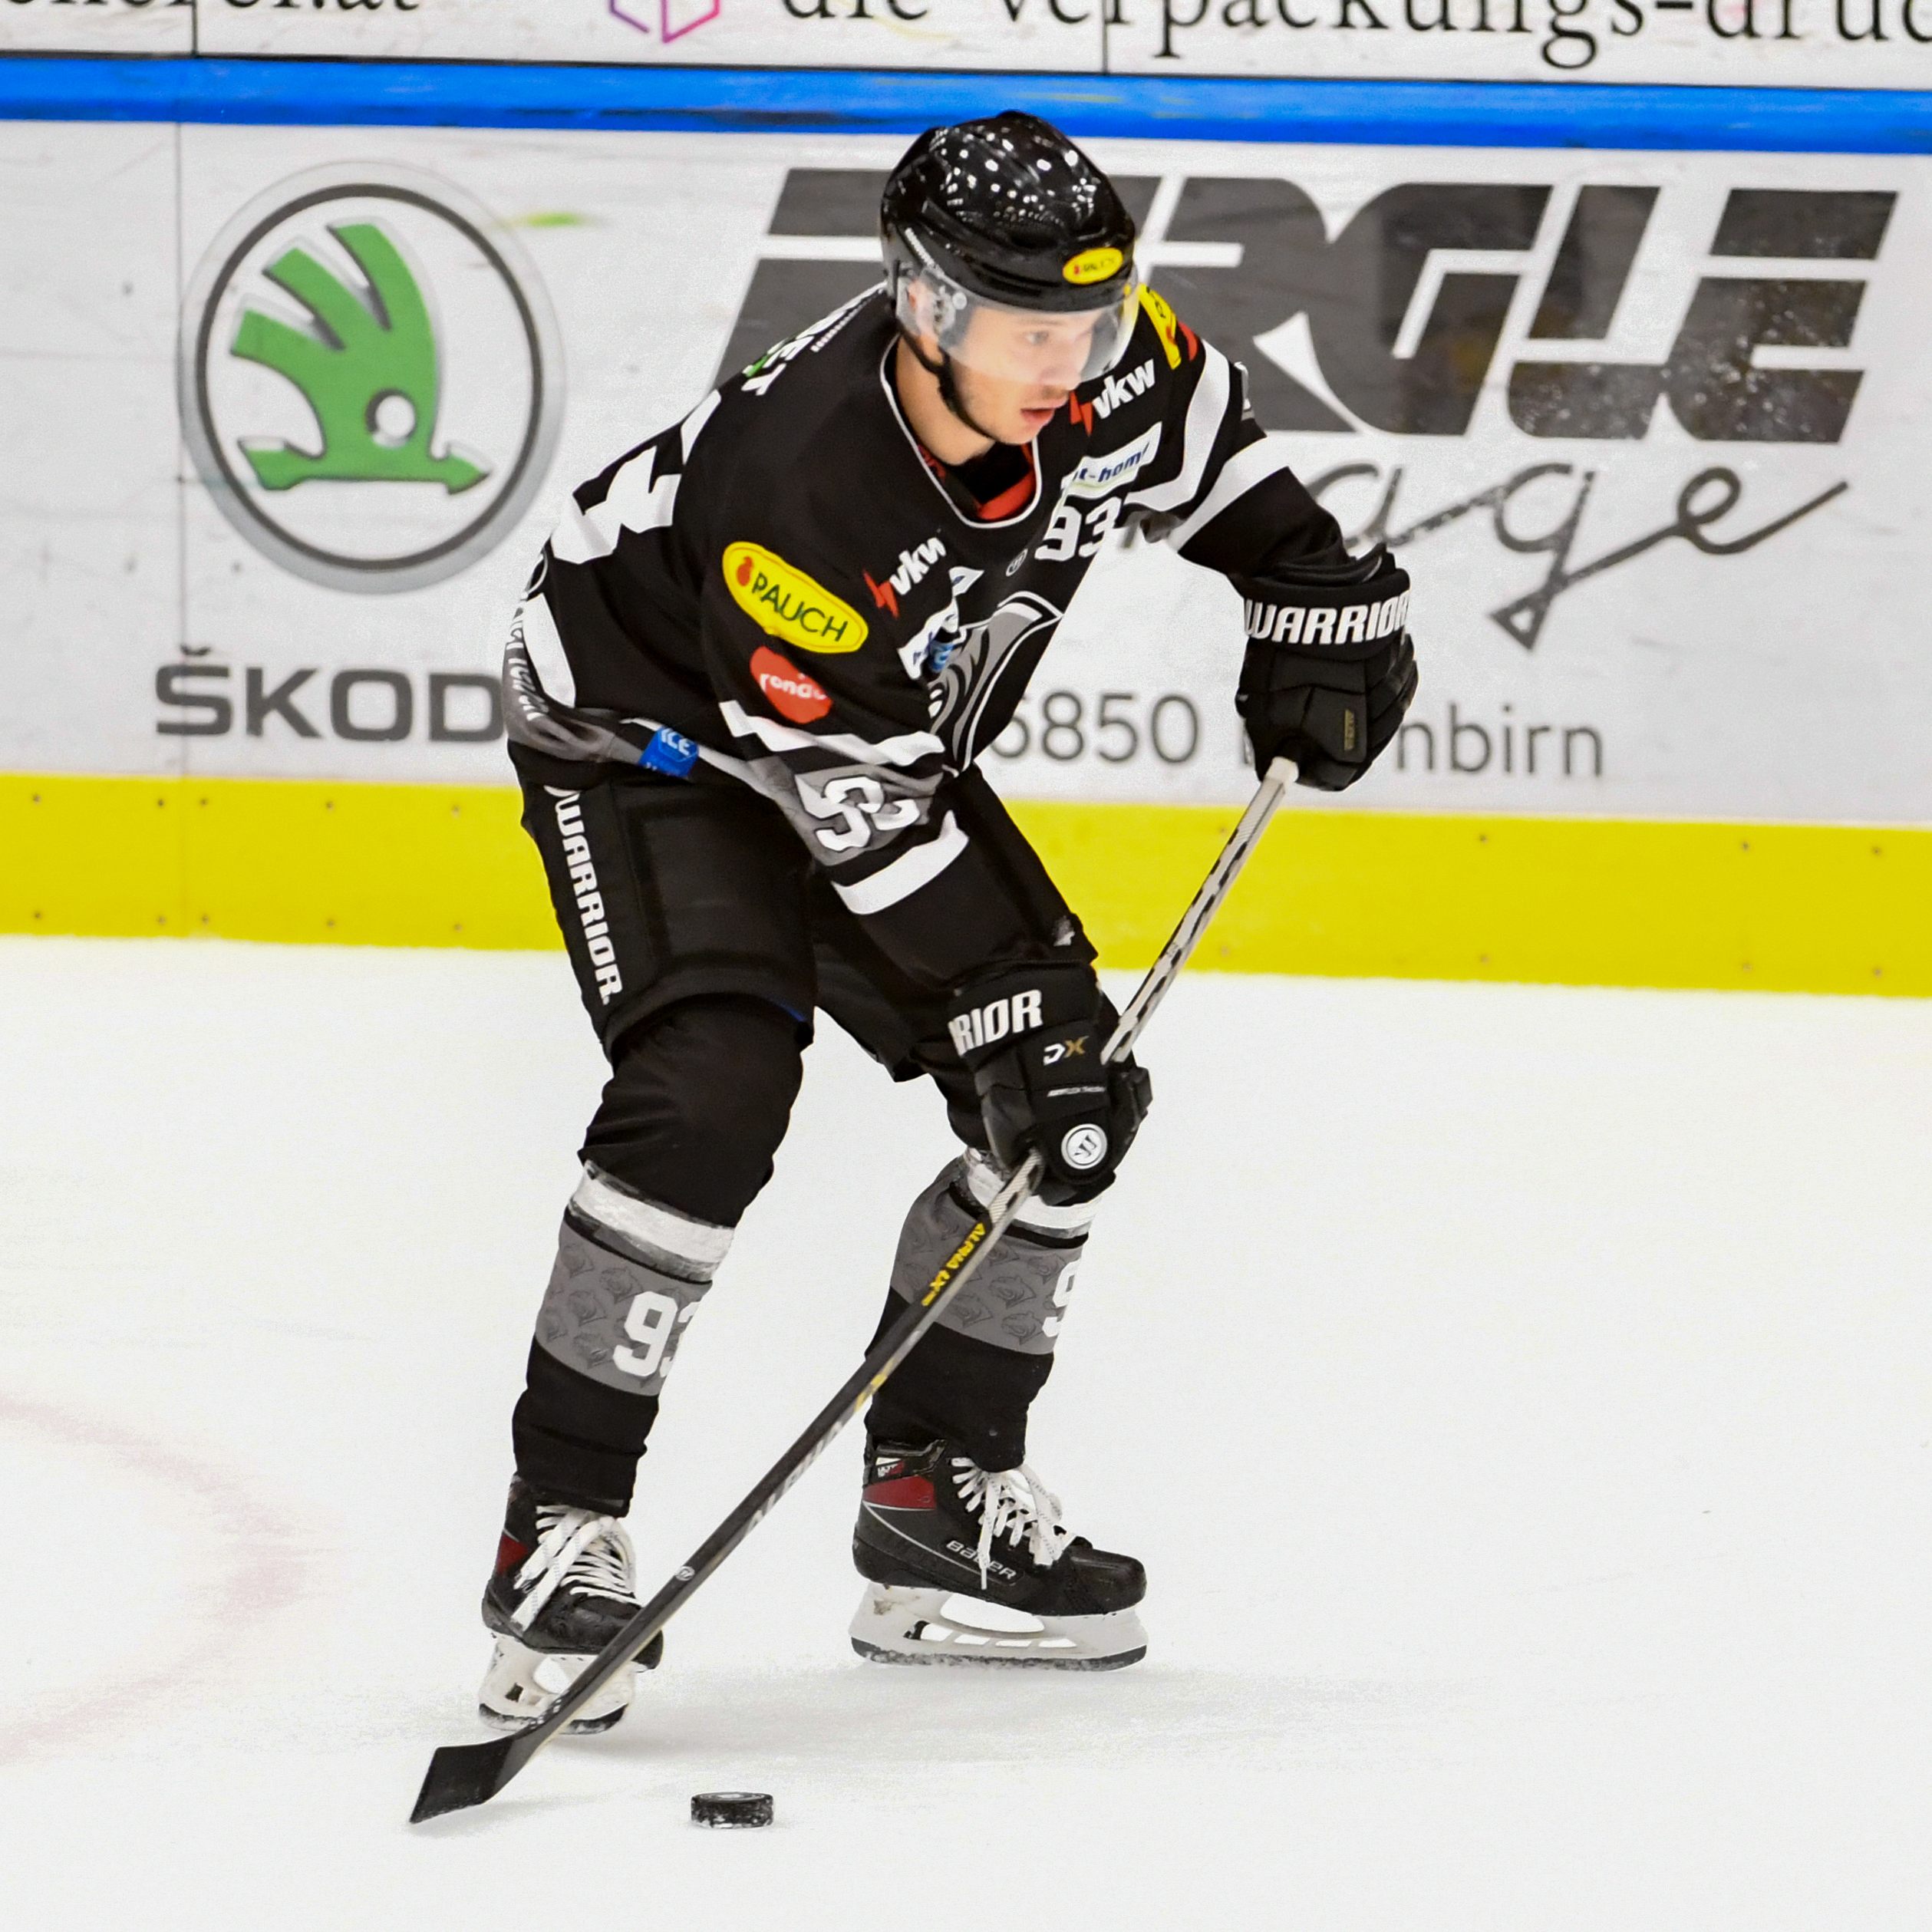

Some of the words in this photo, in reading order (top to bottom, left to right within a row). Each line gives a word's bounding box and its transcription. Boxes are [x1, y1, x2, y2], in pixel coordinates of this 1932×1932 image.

[1093, 358, 1156, 420] vkw
[1072, 440, 1150, 483] t-hom
[1034, 496, 1122, 562] 93
[889, 537, 947, 595] vkw
[155, 644, 505, 743] ŠKOD
[1241, 703, 1603, 776] nbirn
[555, 793, 624, 1005] WARRIOR
